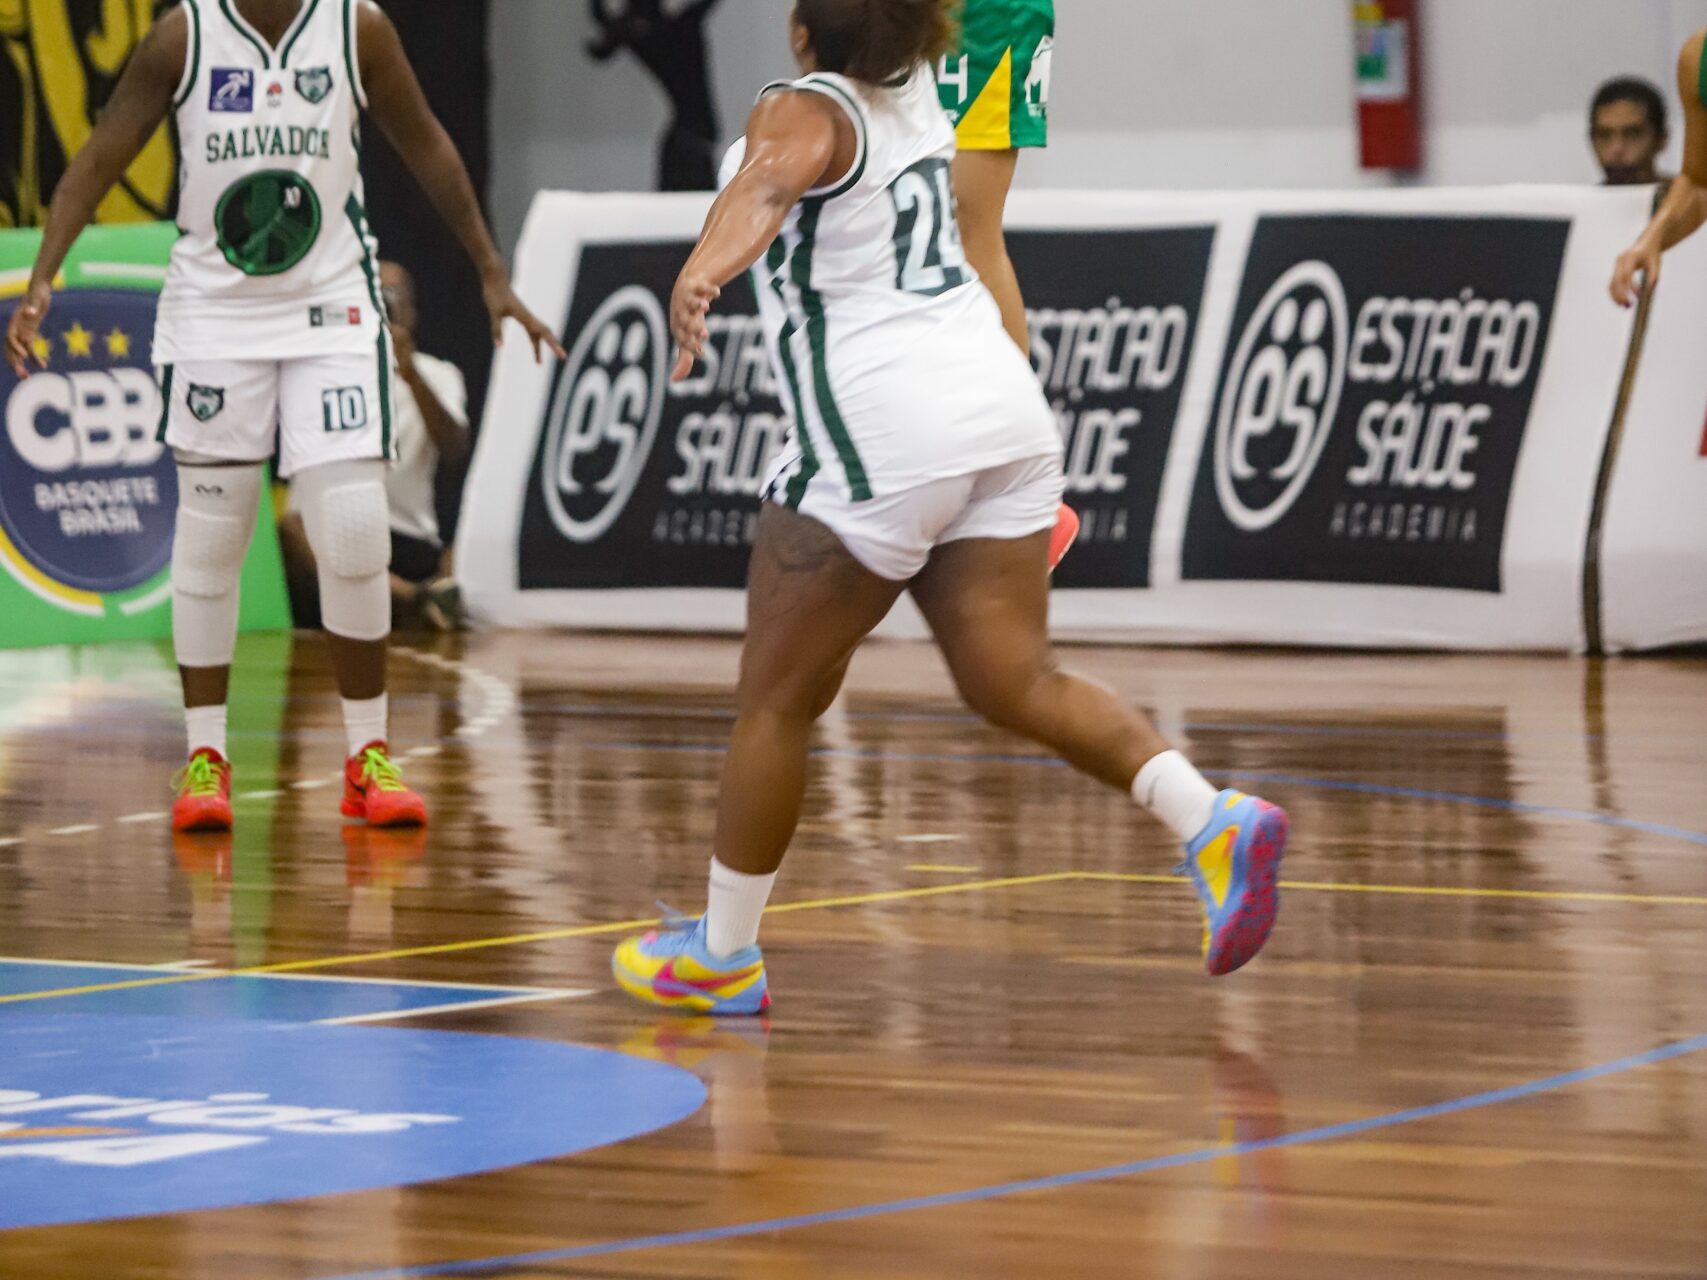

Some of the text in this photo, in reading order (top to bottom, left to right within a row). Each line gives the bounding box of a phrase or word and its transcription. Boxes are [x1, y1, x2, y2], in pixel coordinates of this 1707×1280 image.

[6, 367, 165, 473] CBB
[322, 385, 368, 432] 10
[34, 476, 160, 512] BASQUETE
[59, 506, 143, 538] BRASIL
